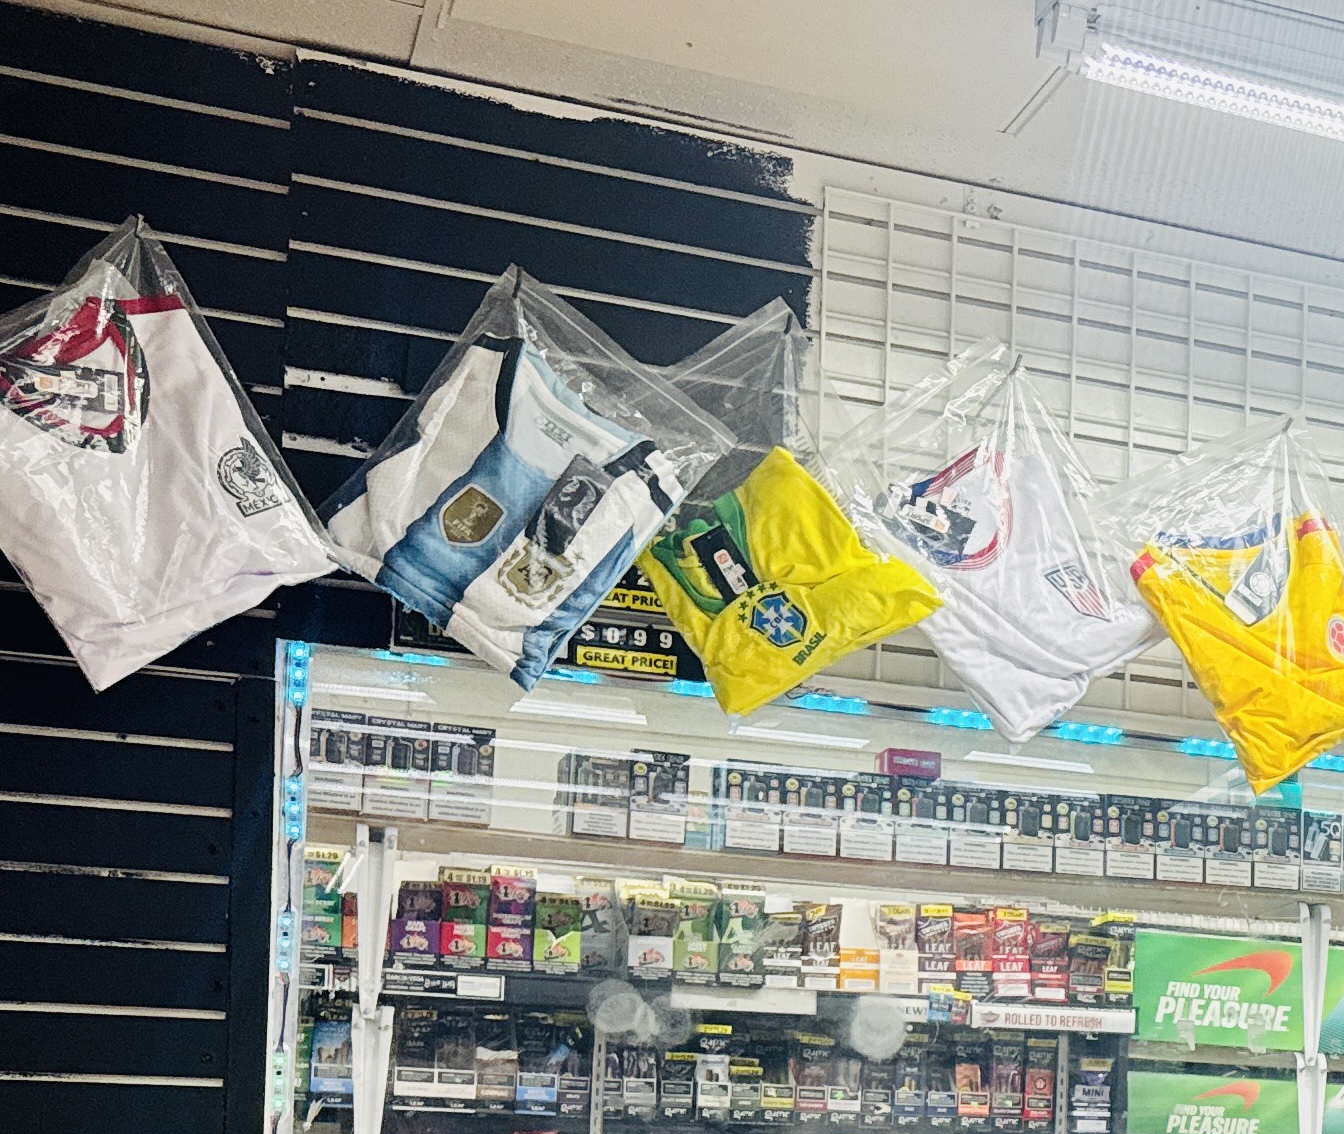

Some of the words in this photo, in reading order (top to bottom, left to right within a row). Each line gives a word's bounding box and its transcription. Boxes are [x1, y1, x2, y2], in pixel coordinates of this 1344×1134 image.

[583, 650, 625, 666] GREAT
[631, 655, 674, 670] PRICE!
[793, 630, 828, 666] BRASIL
[1167, 981, 1200, 997] FIND
[1203, 983, 1240, 1000] YOUR
[1155, 996, 1291, 1032] PLEASURE
